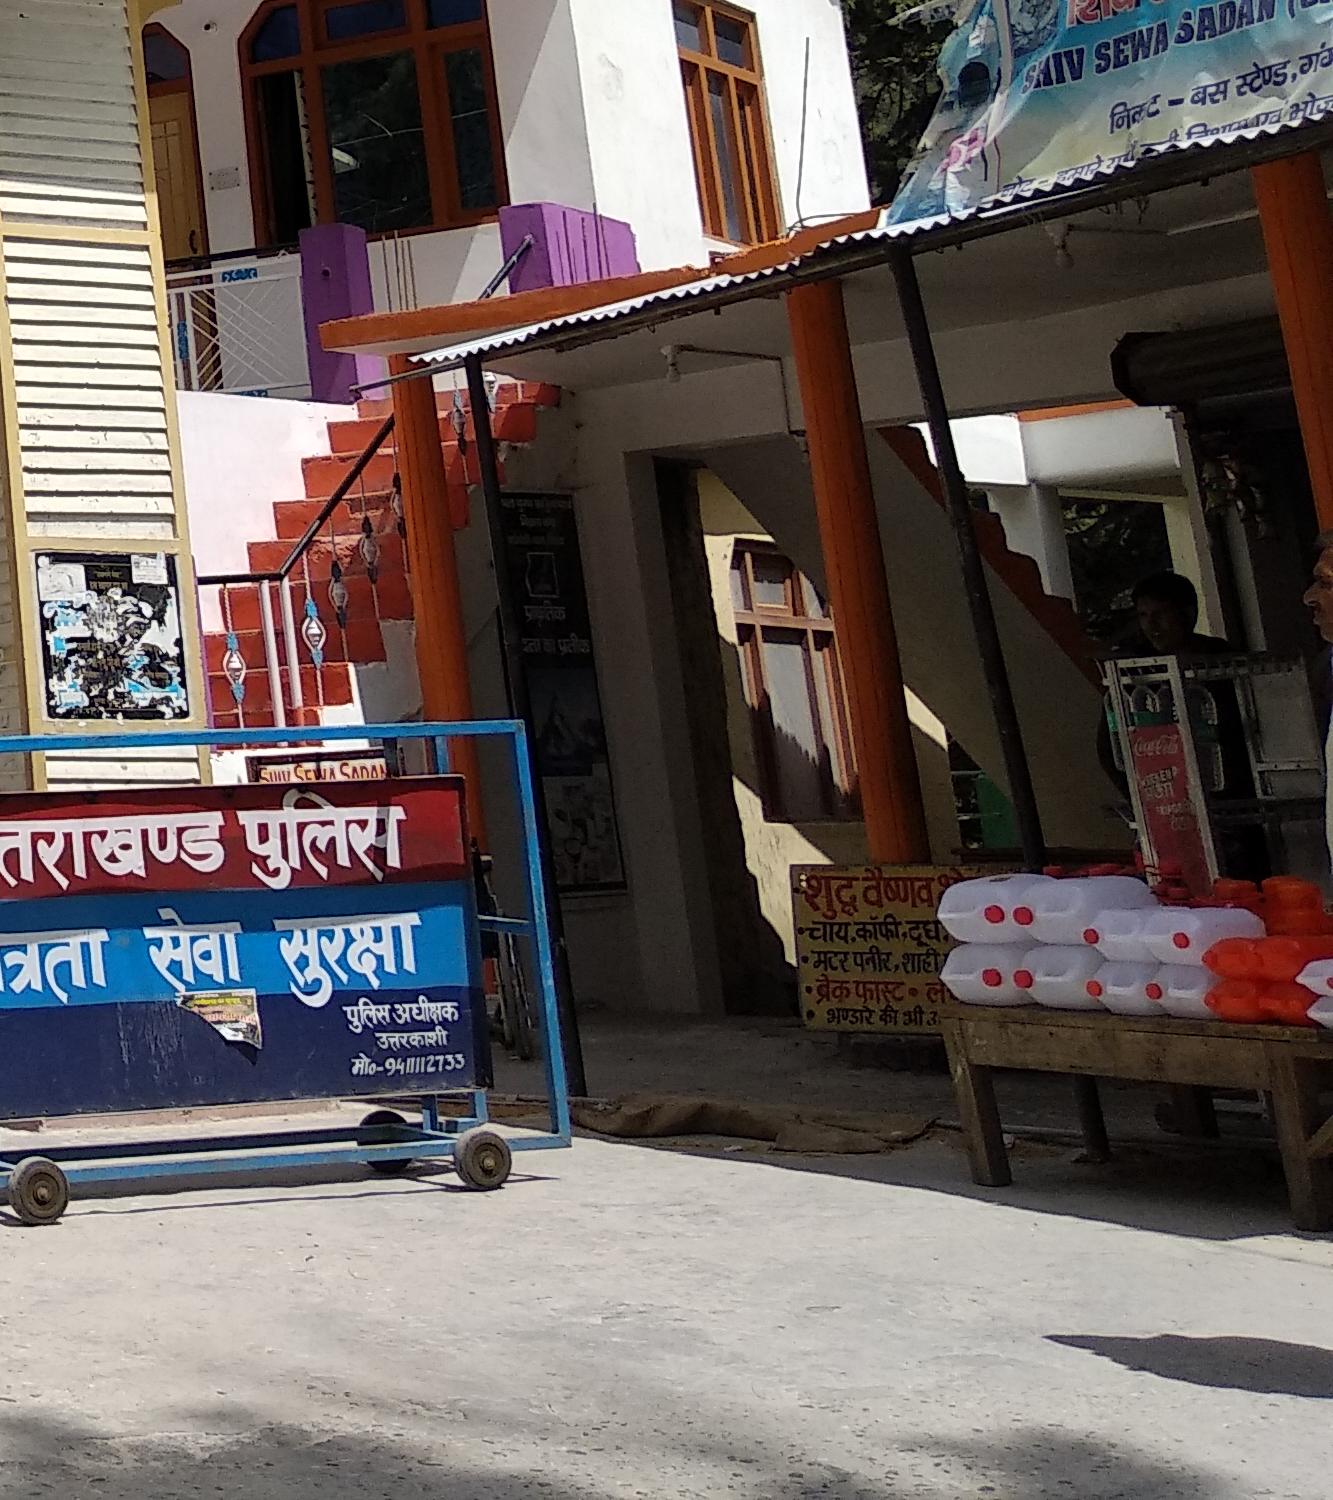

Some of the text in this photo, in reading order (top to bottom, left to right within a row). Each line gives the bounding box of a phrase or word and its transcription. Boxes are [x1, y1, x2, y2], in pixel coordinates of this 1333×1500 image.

[1094, 21, 1169, 74] SEWA
[1191, 79, 1230, 105] बस
[236, 787, 408, 890] पुलिस
[862, 867, 935, 908] वैष्णव
[142, 907, 244, 994] सेवा
[273, 912, 422, 1008] सुरक्षा
[811, 950, 850, 973] मटर
[902, 948, 940, 974] शाही
[815, 974, 905, 1005] ब्रेक फास्ट
[342, 994, 459, 1034] पुलिस अधीक्षक
[826, 1007, 875, 1025] भण्डारे
[879, 1004, 899, 1026] की
[903, 1004, 925, 1026] भी
[374, 1025, 449, 1052] उत्तरकाशी
